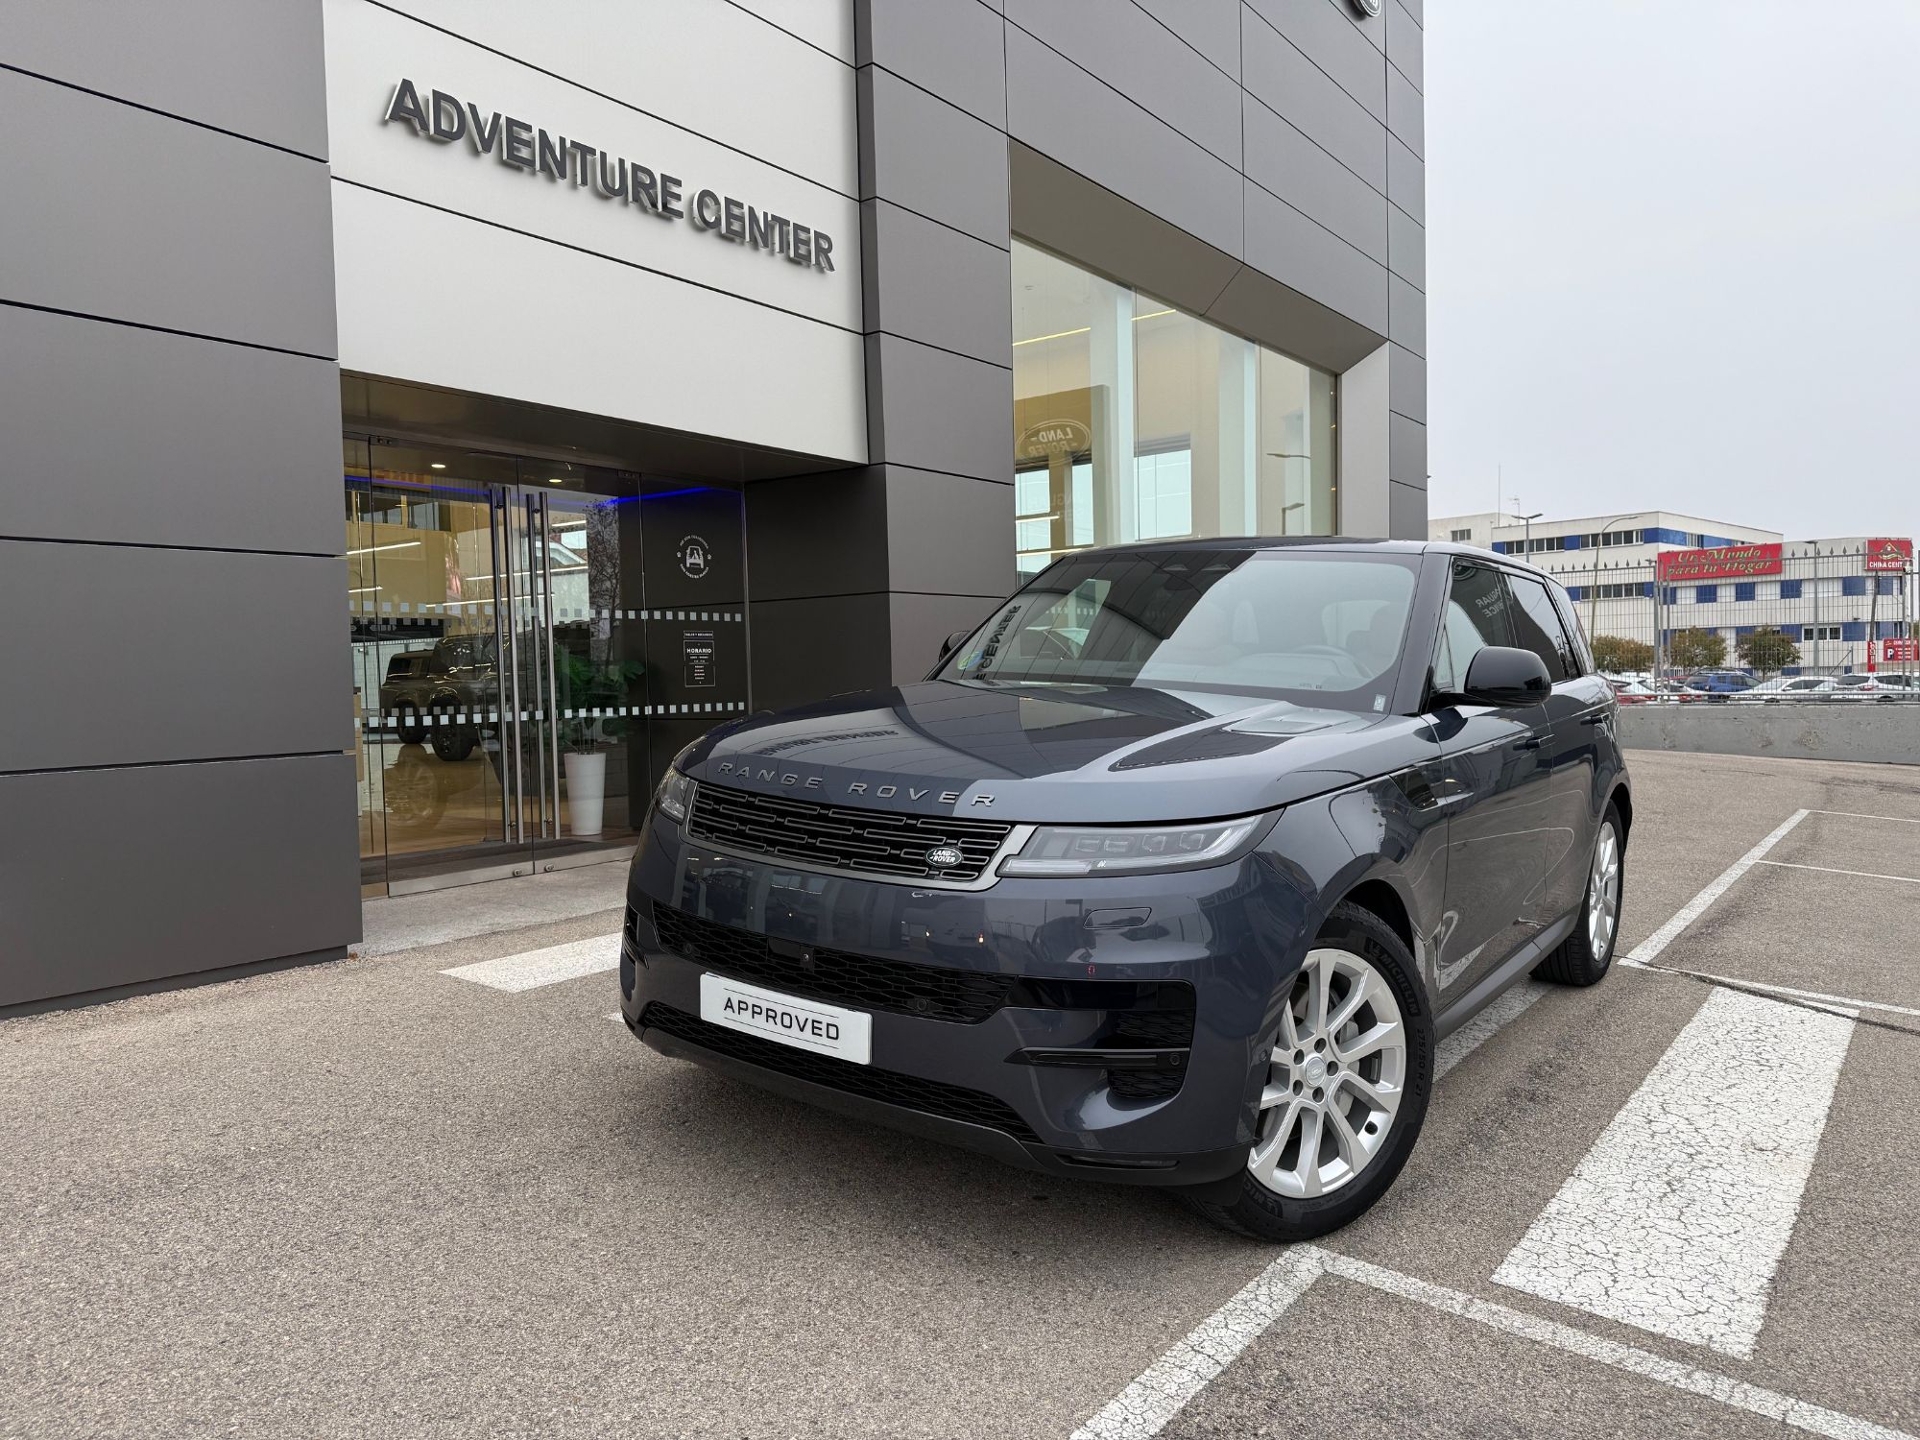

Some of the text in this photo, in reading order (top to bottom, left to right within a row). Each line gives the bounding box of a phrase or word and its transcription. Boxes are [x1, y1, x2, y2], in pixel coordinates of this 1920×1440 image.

[384, 78, 835, 272] ADVENTURE CENTER
[1700, 547, 1760, 562] Mundo
[1721, 561, 1772, 573] Hogar
[1887, 648, 1895, 659] P
[718, 762, 996, 807] RANGE ROVER
[1380, 952, 1419, 1015] MICHELIN
[723, 997, 840, 1041] APPROVED
